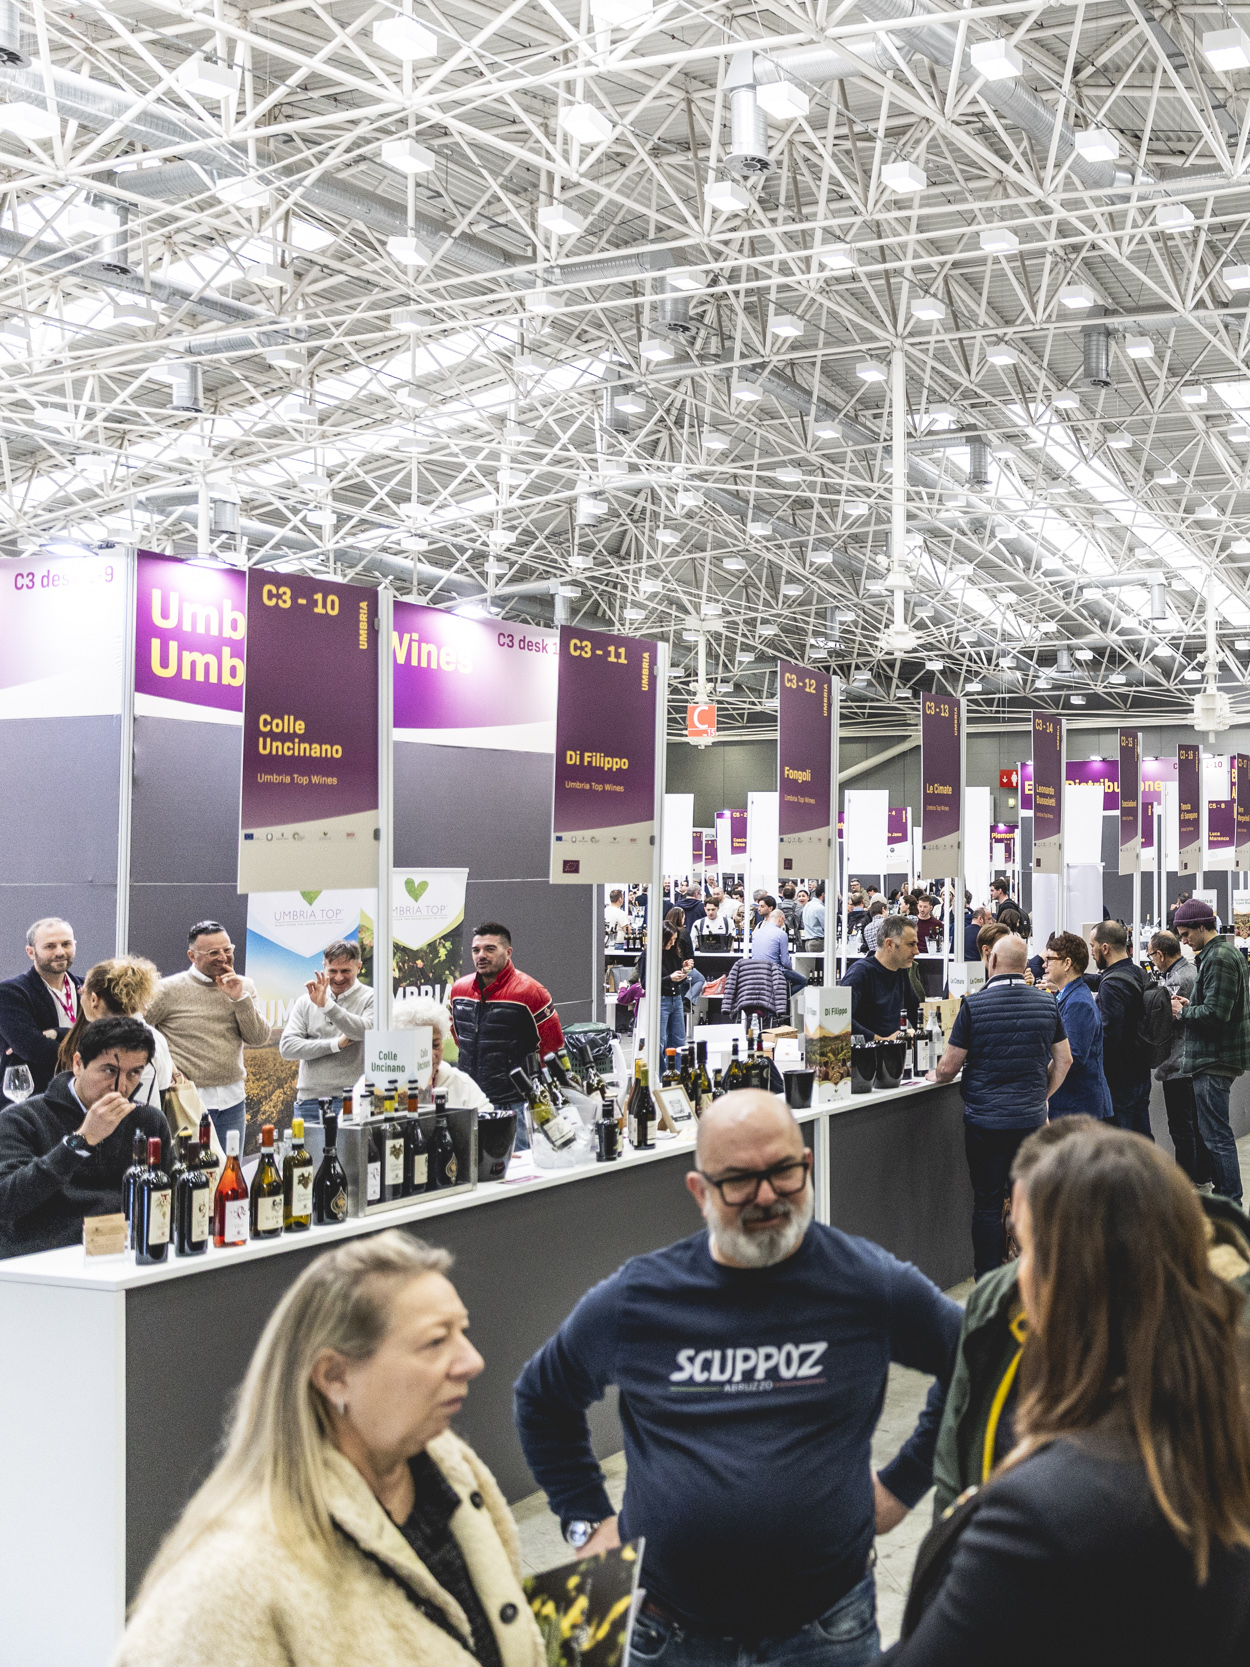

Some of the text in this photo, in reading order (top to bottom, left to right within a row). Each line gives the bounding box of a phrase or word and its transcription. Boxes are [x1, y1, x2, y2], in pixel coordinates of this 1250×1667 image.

[14, 572, 35, 591] C3
[41, 569, 80, 589] des
[262, 584, 292, 608] C3
[314, 593, 339, 616] 10
[151, 588, 245, 640] Umb
[359, 601, 368, 650] UMBRIA
[497, 632, 515, 649] C3
[518, 635, 548, 654] desk
[569, 638, 591, 658] C3
[607, 645, 628, 664] 11
[151, 638, 245, 687] Umb
[641, 652, 650, 691] UMBRIA
[785, 672, 798, 688] C3
[804, 678, 816, 694] 12
[693, 705, 709, 729] C
[926, 701, 935, 715] C3
[940, 704, 949, 717] 13
[259, 714, 305, 734] Colle
[1035, 719, 1042, 731] C3
[1046, 722, 1053, 733] 14
[258, 737, 342, 759] Uncinano
[566, 751, 629, 771] Di Filippo
[257, 772, 338, 786] Umbria Top Wines
[784, 766, 811, 783] Fongoli
[565, 781, 624, 793] Umbria Top Wines
[926, 783, 952, 795] Le Cimate
[274, 908, 342, 921] UMBRIA TOP
[392, 904, 446, 915] MBRIA TOP
[824, 1007, 848, 1016] Di Filippo
[378, 1051, 398, 1061] Colle
[371, 1061, 406, 1073] Uncinano
[669, 1341, 828, 1383] SCUPPOZ
[724, 1380, 774, 1393] ABRUZZO
